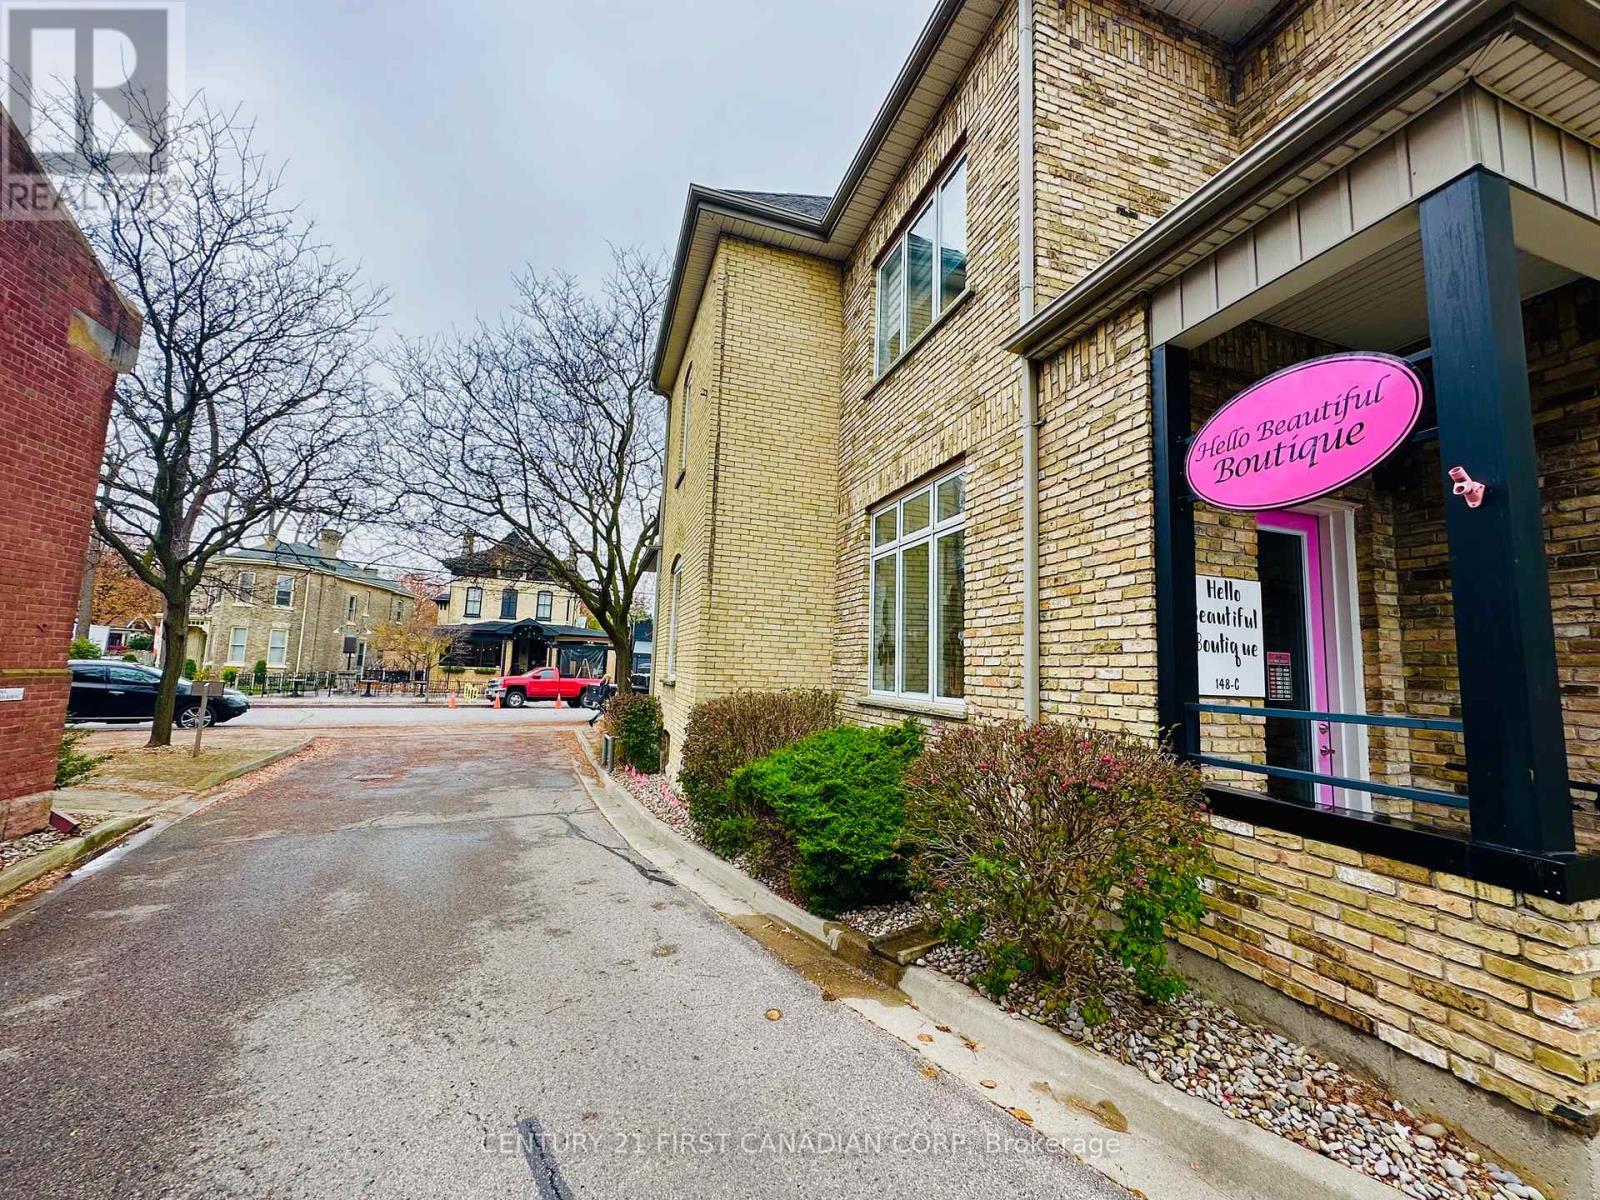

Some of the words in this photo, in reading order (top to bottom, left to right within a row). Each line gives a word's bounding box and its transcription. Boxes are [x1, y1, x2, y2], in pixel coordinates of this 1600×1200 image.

[1195, 426, 1250, 462] Hello
[1257, 374, 1391, 442] Beautiful
[1213, 421, 1365, 485] Boutique
[1206, 579, 1241, 602] Hello
[1197, 606, 1258, 629] eautiful
[1215, 677, 1240, 690] 148-C
